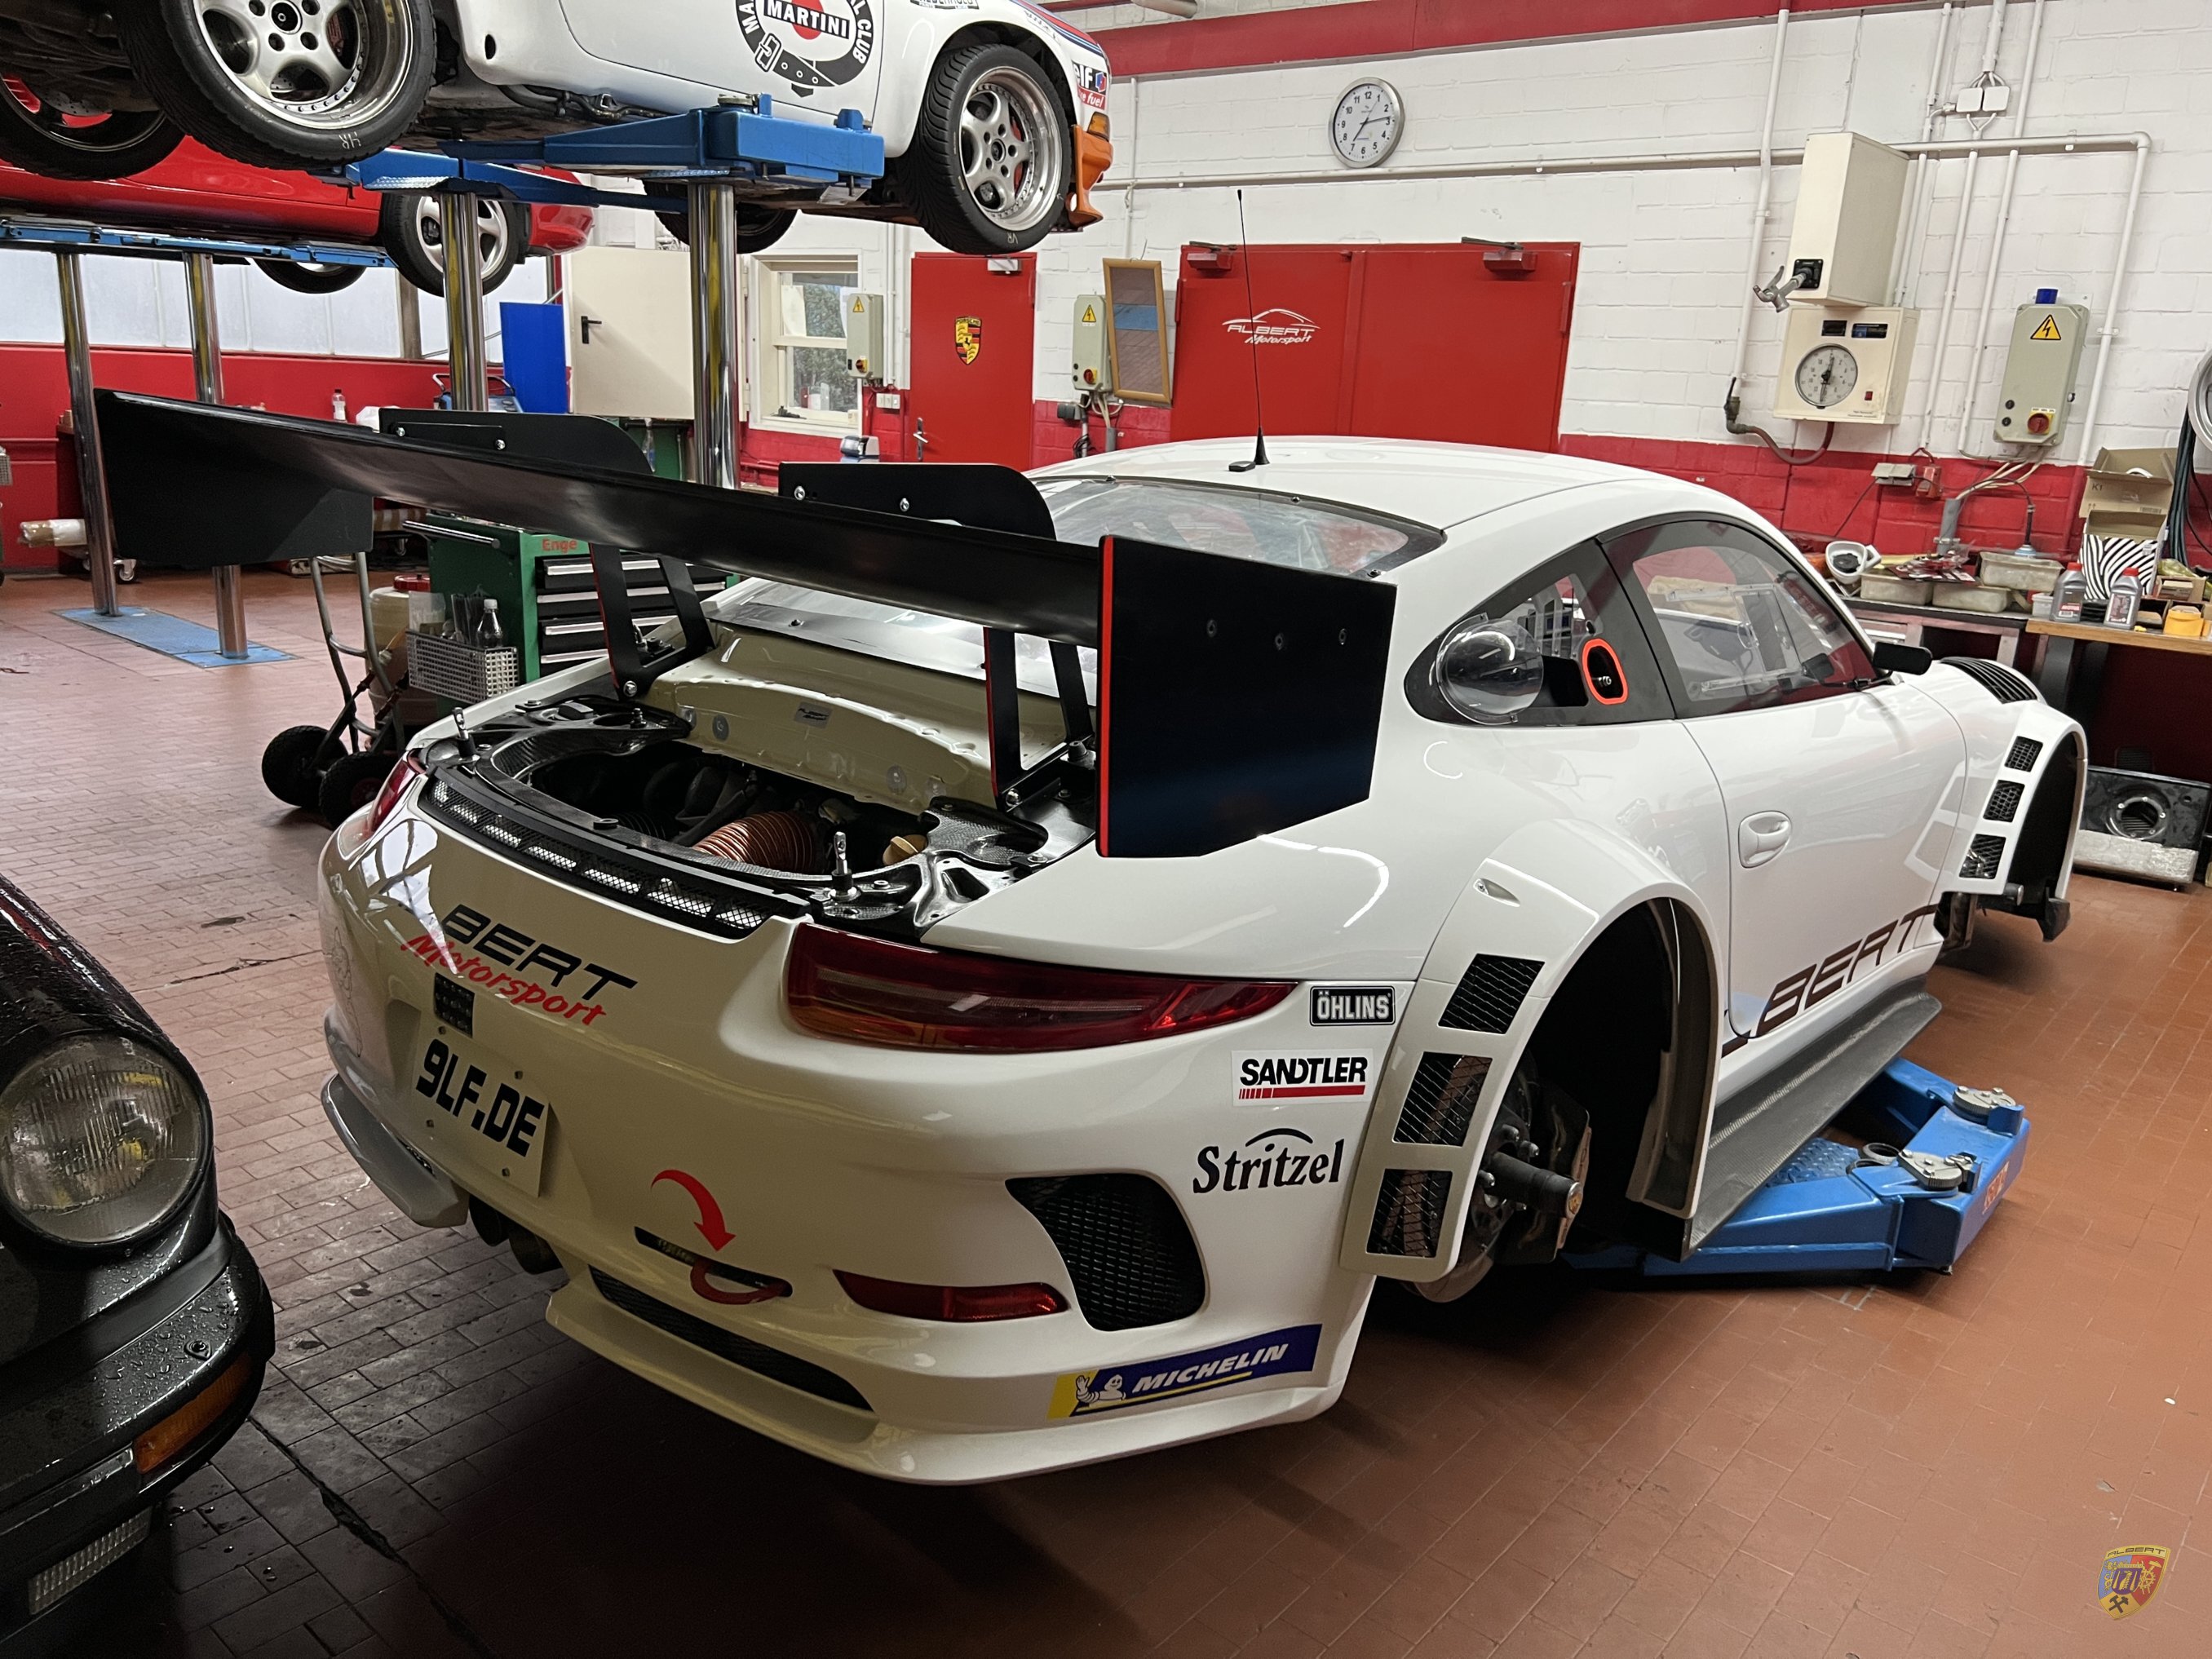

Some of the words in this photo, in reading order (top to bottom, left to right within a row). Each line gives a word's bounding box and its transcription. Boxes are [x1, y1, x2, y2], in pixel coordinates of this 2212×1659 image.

[739, 0, 760, 34] MA
[767, 0, 848, 38] MARTINI
[852, 19, 872, 64] CLUB
[1073, 63, 1094, 89] elf
[1087, 92, 1104, 108] fuel
[1353, 95, 1360, 104] 11
[1364, 91, 1372, 100] 12
[1377, 94, 1381, 103] 1
[1346, 106, 1353, 114] 10
[1383, 104, 1389, 113] 2
[1341, 120, 1346, 128] 9
[1385, 117, 1391, 126] 3
[1343, 133, 1347, 141] 8
[1360, 146, 1366, 154] 6
[1372, 142, 1378, 150] 5
[1228, 325, 1315, 337] ALBERT
[1245, 334, 1312, 345] Motorsport
[542, 538, 577, 554] Enge
[400, 934, 607, 1025] Motorsport
[1316, 990, 1391, 1020] ÖHLINS
[1240, 1056, 1369, 1086] SANDTLER
[416, 1038, 545, 1157] 9LF.DE
[1193, 1139, 1344, 1193] Stritzel
[1132, 1344, 1289, 1393] MICHELIN
